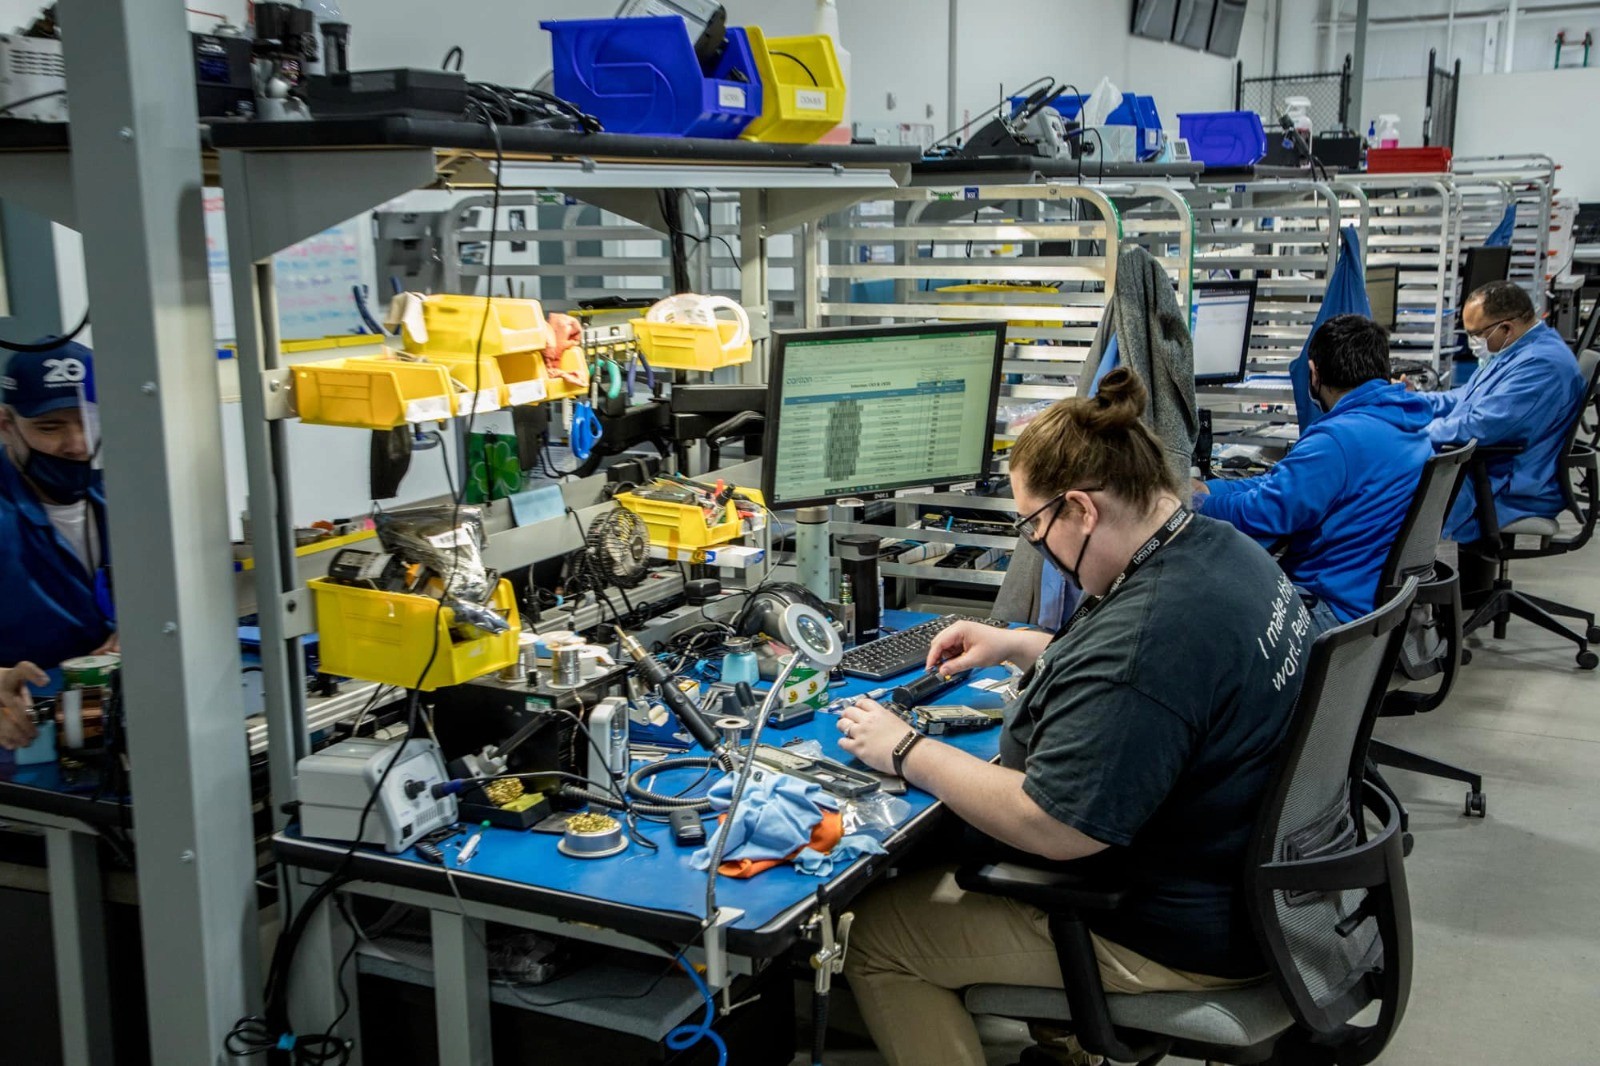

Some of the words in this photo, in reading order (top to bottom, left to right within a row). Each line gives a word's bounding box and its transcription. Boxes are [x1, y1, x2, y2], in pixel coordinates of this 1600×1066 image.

[42, 357, 87, 383] 20
[1257, 637, 1270, 660] I
[1265, 597, 1288, 648] make
